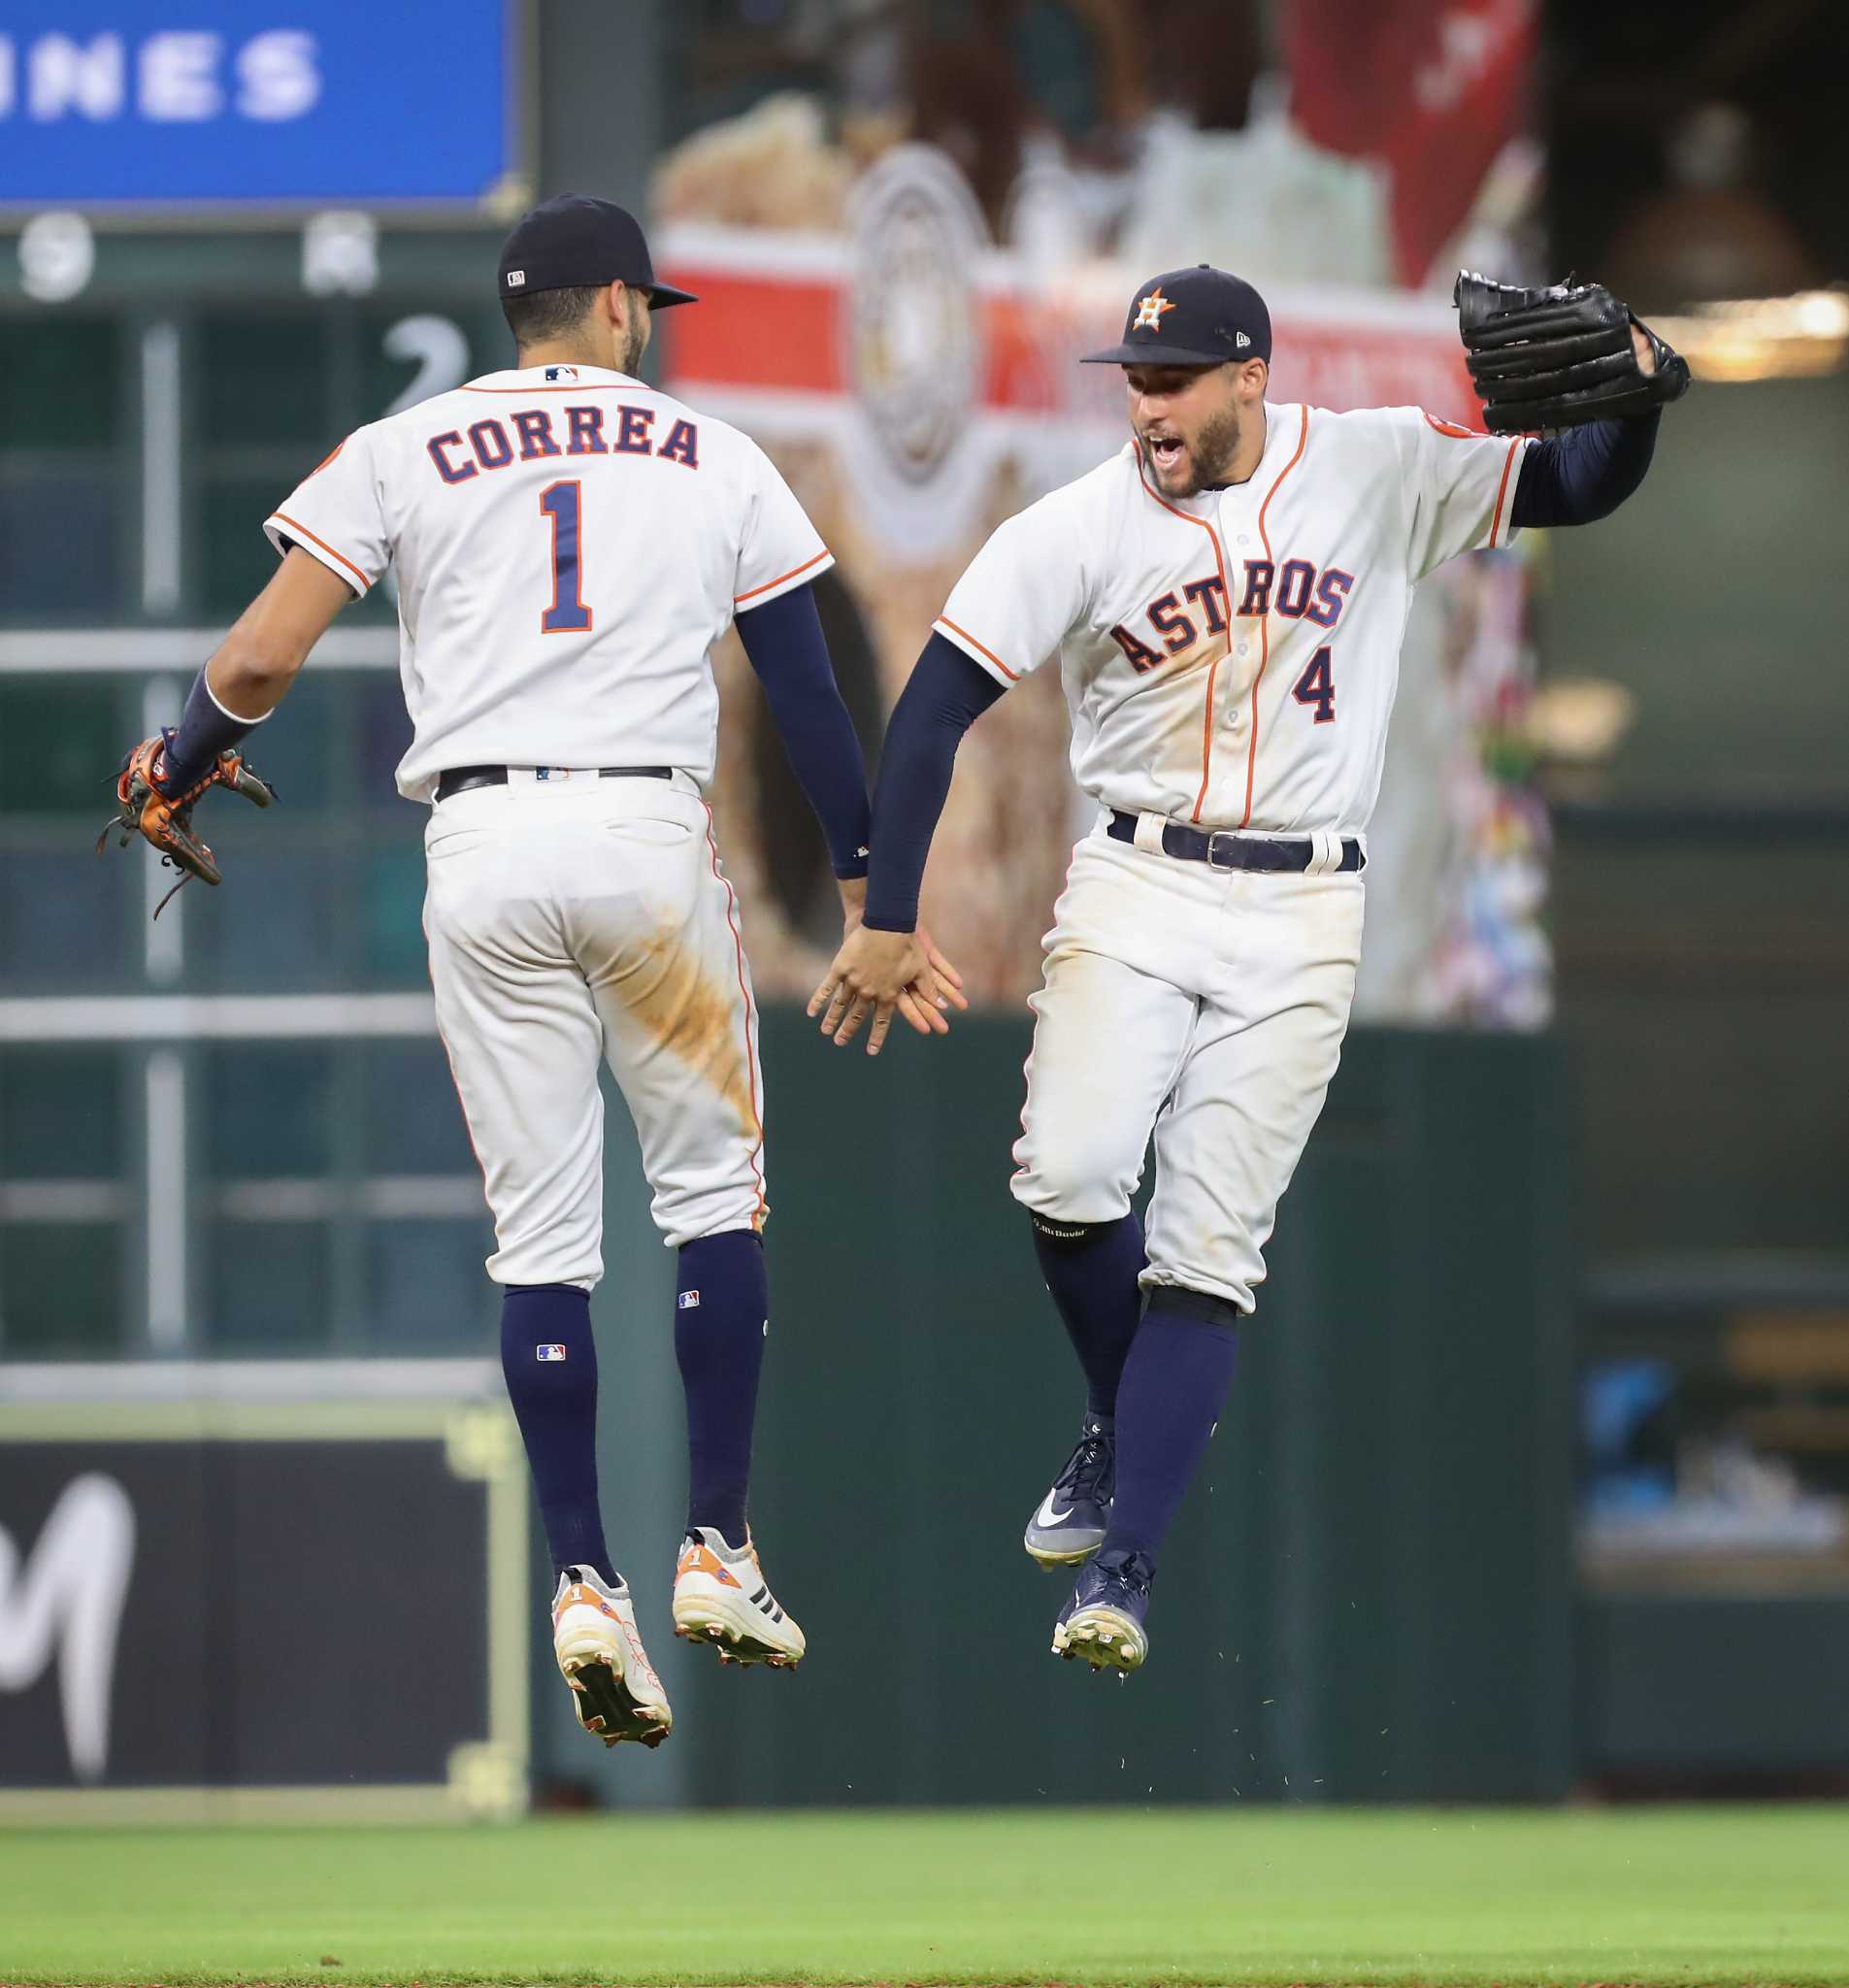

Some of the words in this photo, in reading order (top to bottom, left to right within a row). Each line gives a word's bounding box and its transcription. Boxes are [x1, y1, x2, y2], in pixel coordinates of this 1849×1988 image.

[384, 315, 470, 417] 2
[427, 405, 699, 484] CORREA
[540, 480, 592, 634] 1
[1109, 558, 1355, 676] ASTROS
[1292, 645, 1336, 724] 4
[570, 1585, 583, 1602] 1
[688, 1549, 702, 1566] 1
